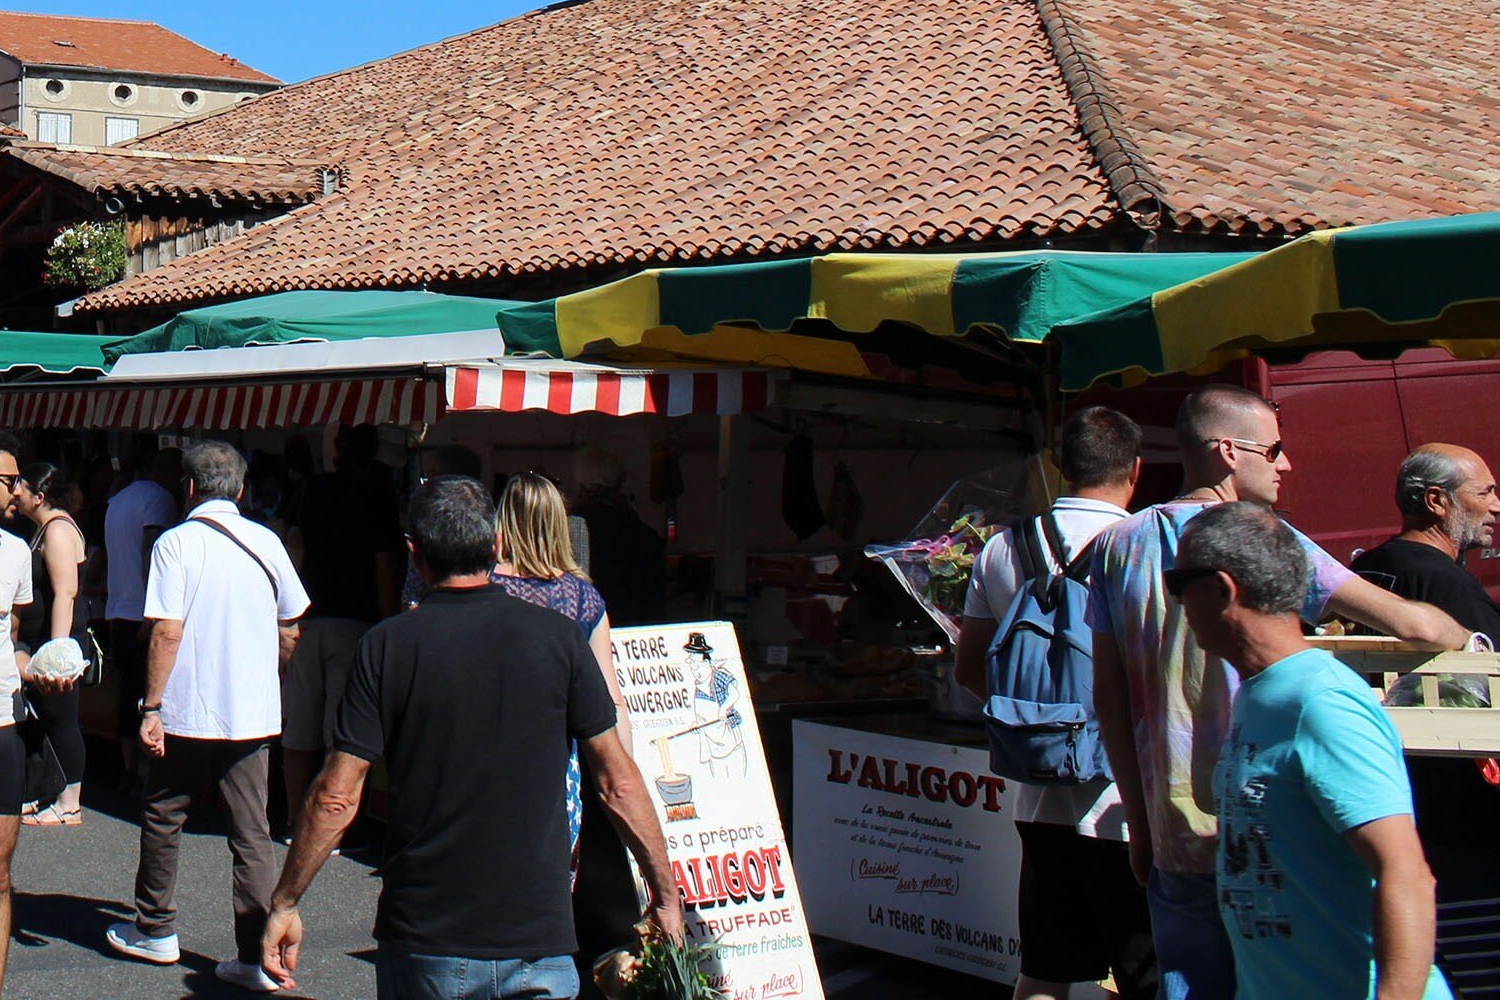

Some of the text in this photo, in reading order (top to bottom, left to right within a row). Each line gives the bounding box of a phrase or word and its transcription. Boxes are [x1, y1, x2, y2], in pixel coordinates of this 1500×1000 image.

[611, 636, 668, 662] A TERRE
[616, 664, 684, 687] S VOLCANS
[827, 749, 1007, 812] L'ALIGOT
[683, 833, 694, 848] a
[666, 845, 786, 911] ALIGOT
[896, 877, 918, 891] sur
[684, 923, 695, 938] A
[868, 904, 884, 926] LA
[888, 908, 926, 935] TERRE
[931, 919, 952, 941] DES
[955, 922, 1004, 954] VOLCANS
